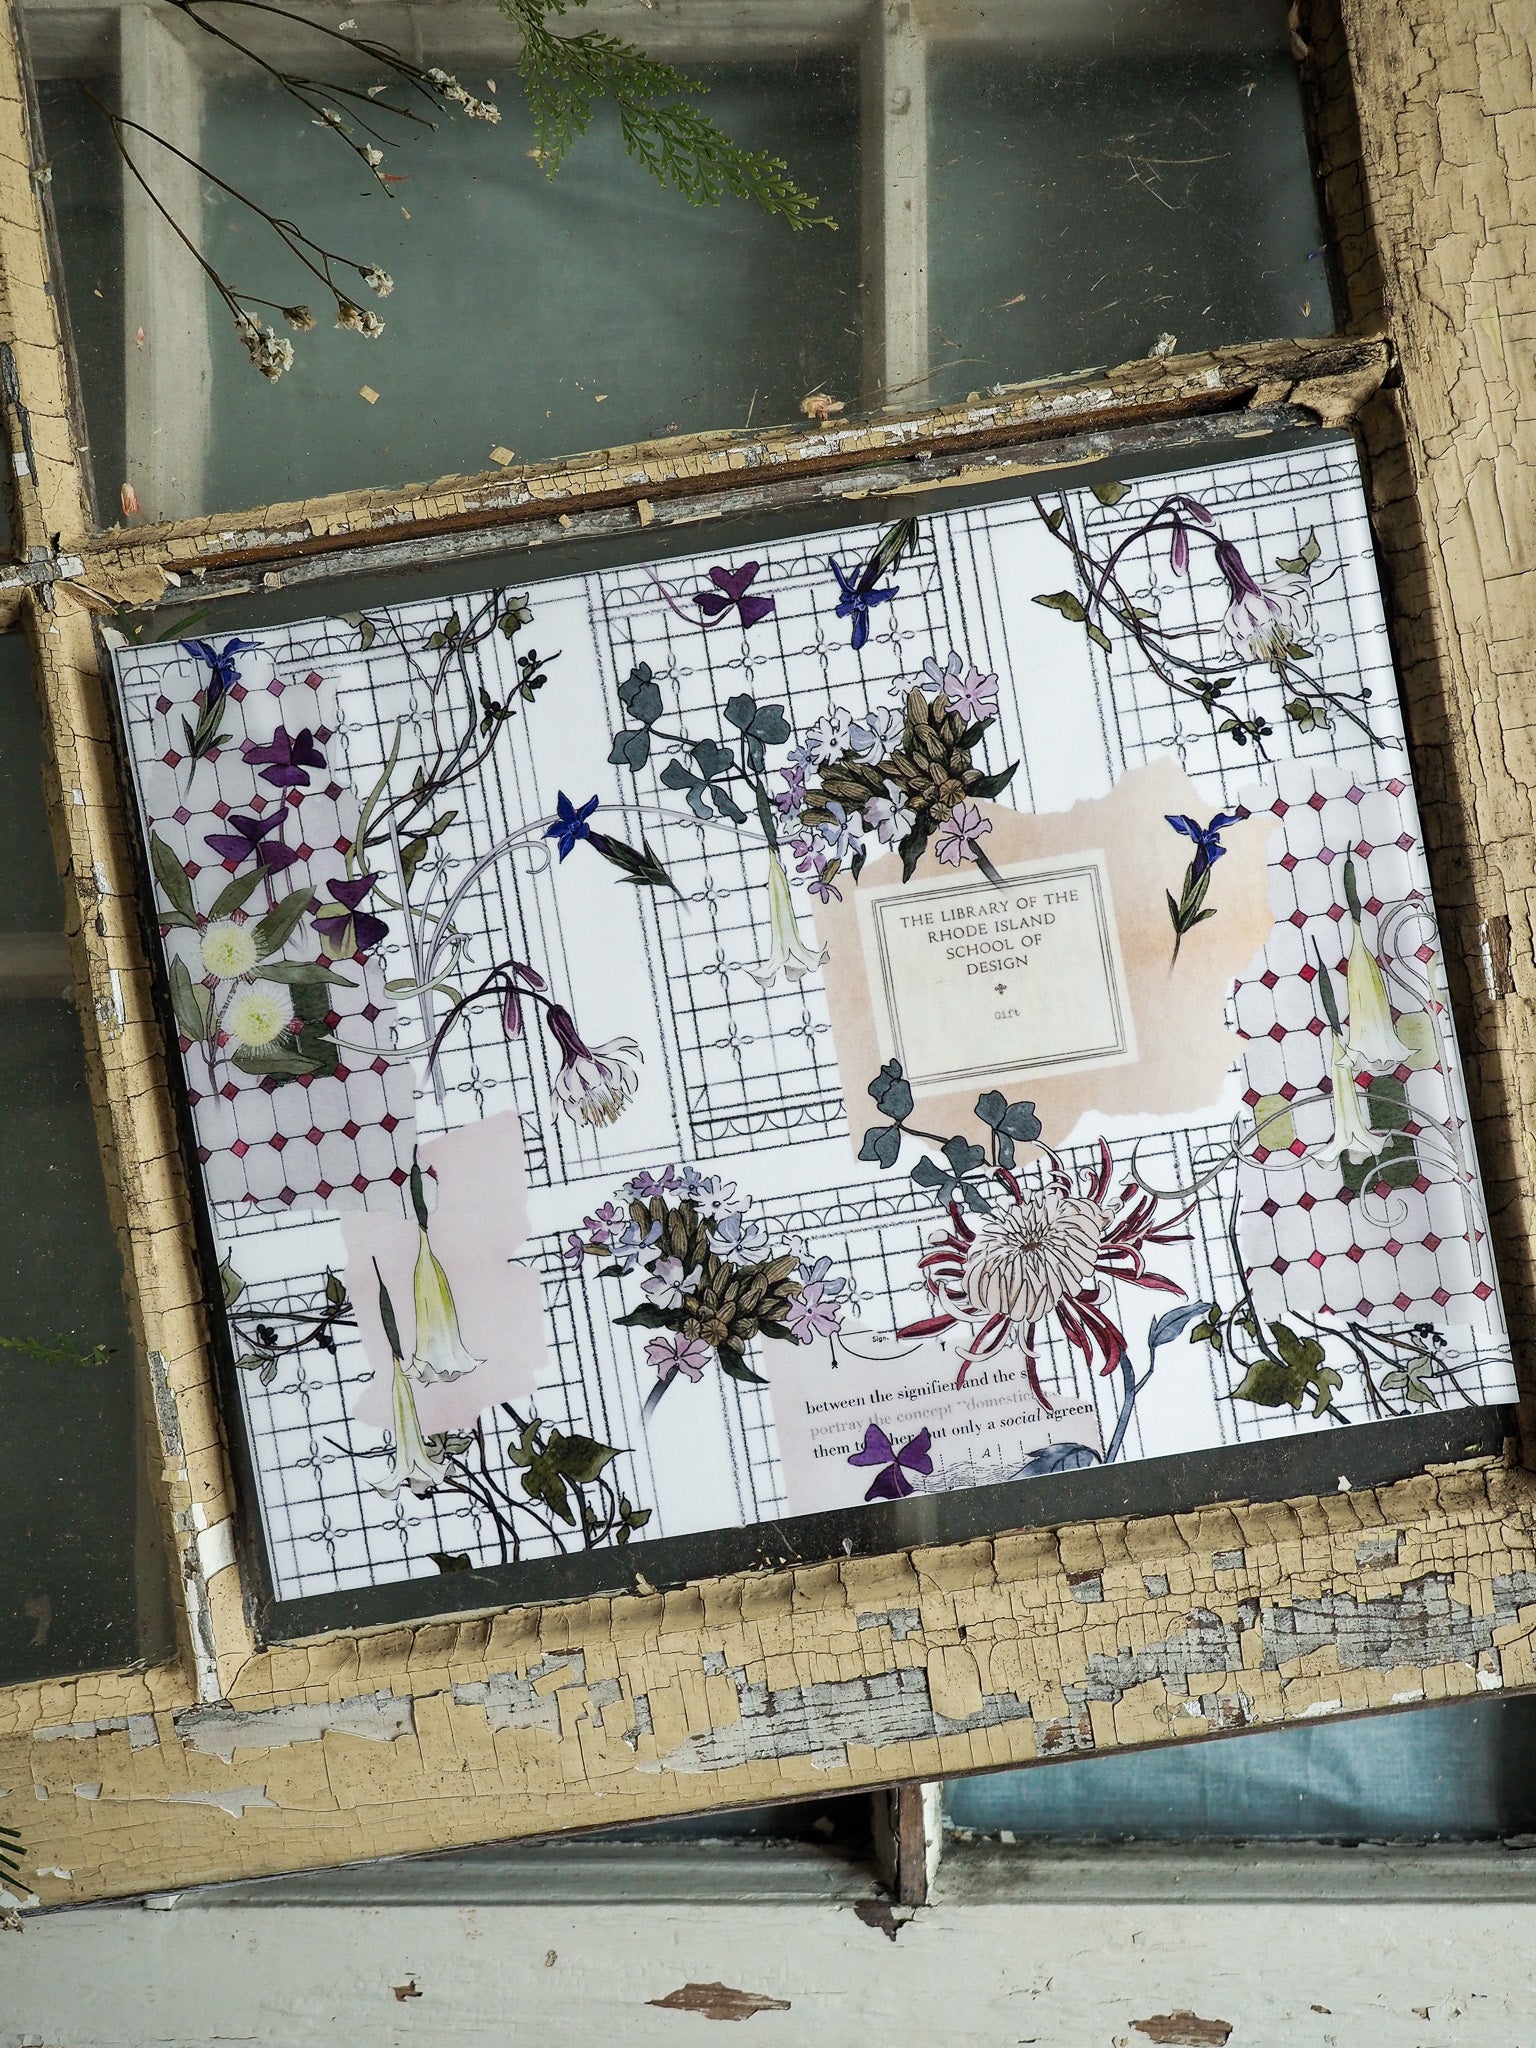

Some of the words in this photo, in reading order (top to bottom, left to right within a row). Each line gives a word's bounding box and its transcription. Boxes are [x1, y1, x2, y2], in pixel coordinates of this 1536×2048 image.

[900, 912, 935, 929] THE
[940, 901, 1009, 922] LIBRARY
[1015, 896, 1038, 910] OF
[1043, 889, 1080, 906] THE
[928, 923, 989, 944] RHODE
[994, 912, 1056, 933] ISLAND
[946, 938, 1015, 960] SCHOOL
[1021, 933, 1043, 948] OF
[967, 955, 1029, 976] DESIGN
[994, 1008, 1021, 1020] Gift
[805, 1397, 865, 1414] between
[870, 1390, 893, 1404] the
[962, 1371, 989, 1389] and
[993, 1369, 1016, 1383] the
[810, 1418, 863, 1440] portray
[869, 1413, 892, 1426] the
[896, 1403, 953, 1424] concept
[813, 1444, 850, 1458] them
[928, 1427, 948, 1439] ut
[951, 1419, 982, 1437] only
[987, 1421, 996, 1430] a
[1000, 1408, 1041, 1428] social
